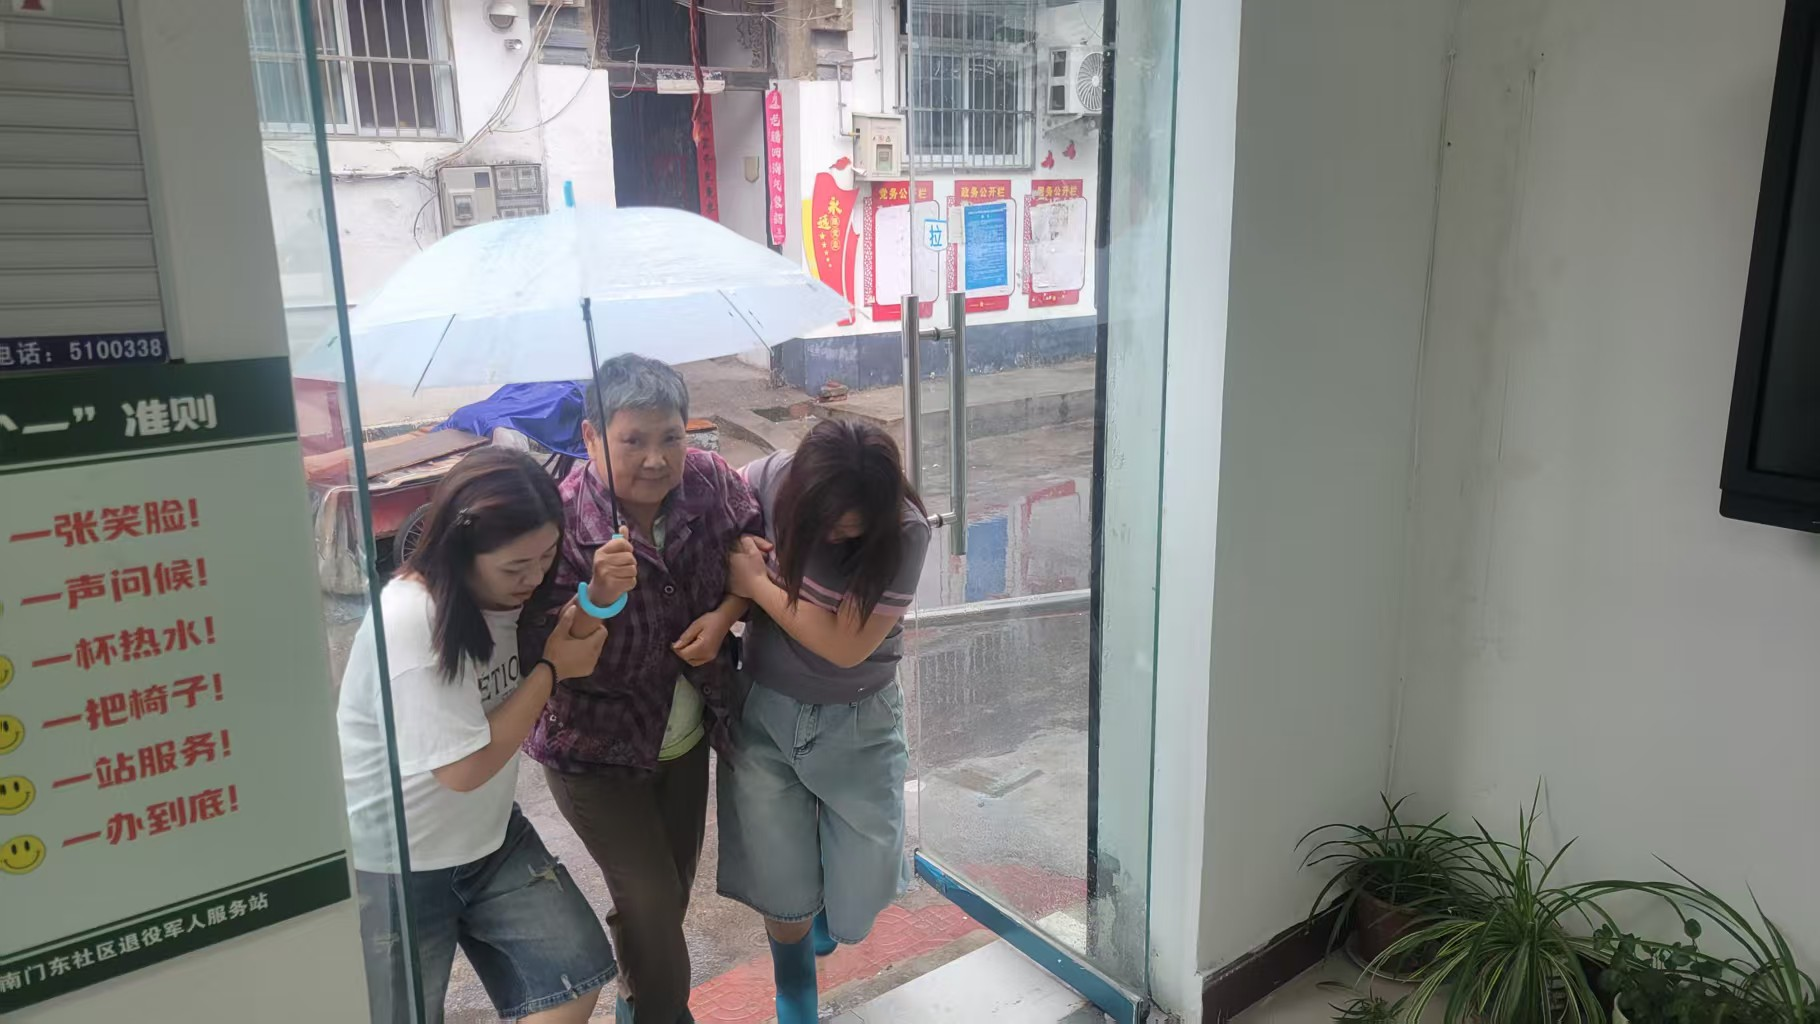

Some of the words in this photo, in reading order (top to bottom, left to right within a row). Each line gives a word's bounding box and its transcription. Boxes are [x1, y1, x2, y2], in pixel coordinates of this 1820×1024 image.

[878, 187, 928, 200] 党务公栏
[960, 186, 1006, 199] 政务公开栏
[928, 225, 943, 248] 拉
[9, 498, 201, 549] 一张笑脸！
[20, 557, 210, 610] 一声问候！
[31, 615, 217, 671] 一杯热水！
[41, 673, 226, 732] 一把椅子！
[52, 729, 233, 790] 一站服务！
[62, 784, 241, 848] 一办到底！
